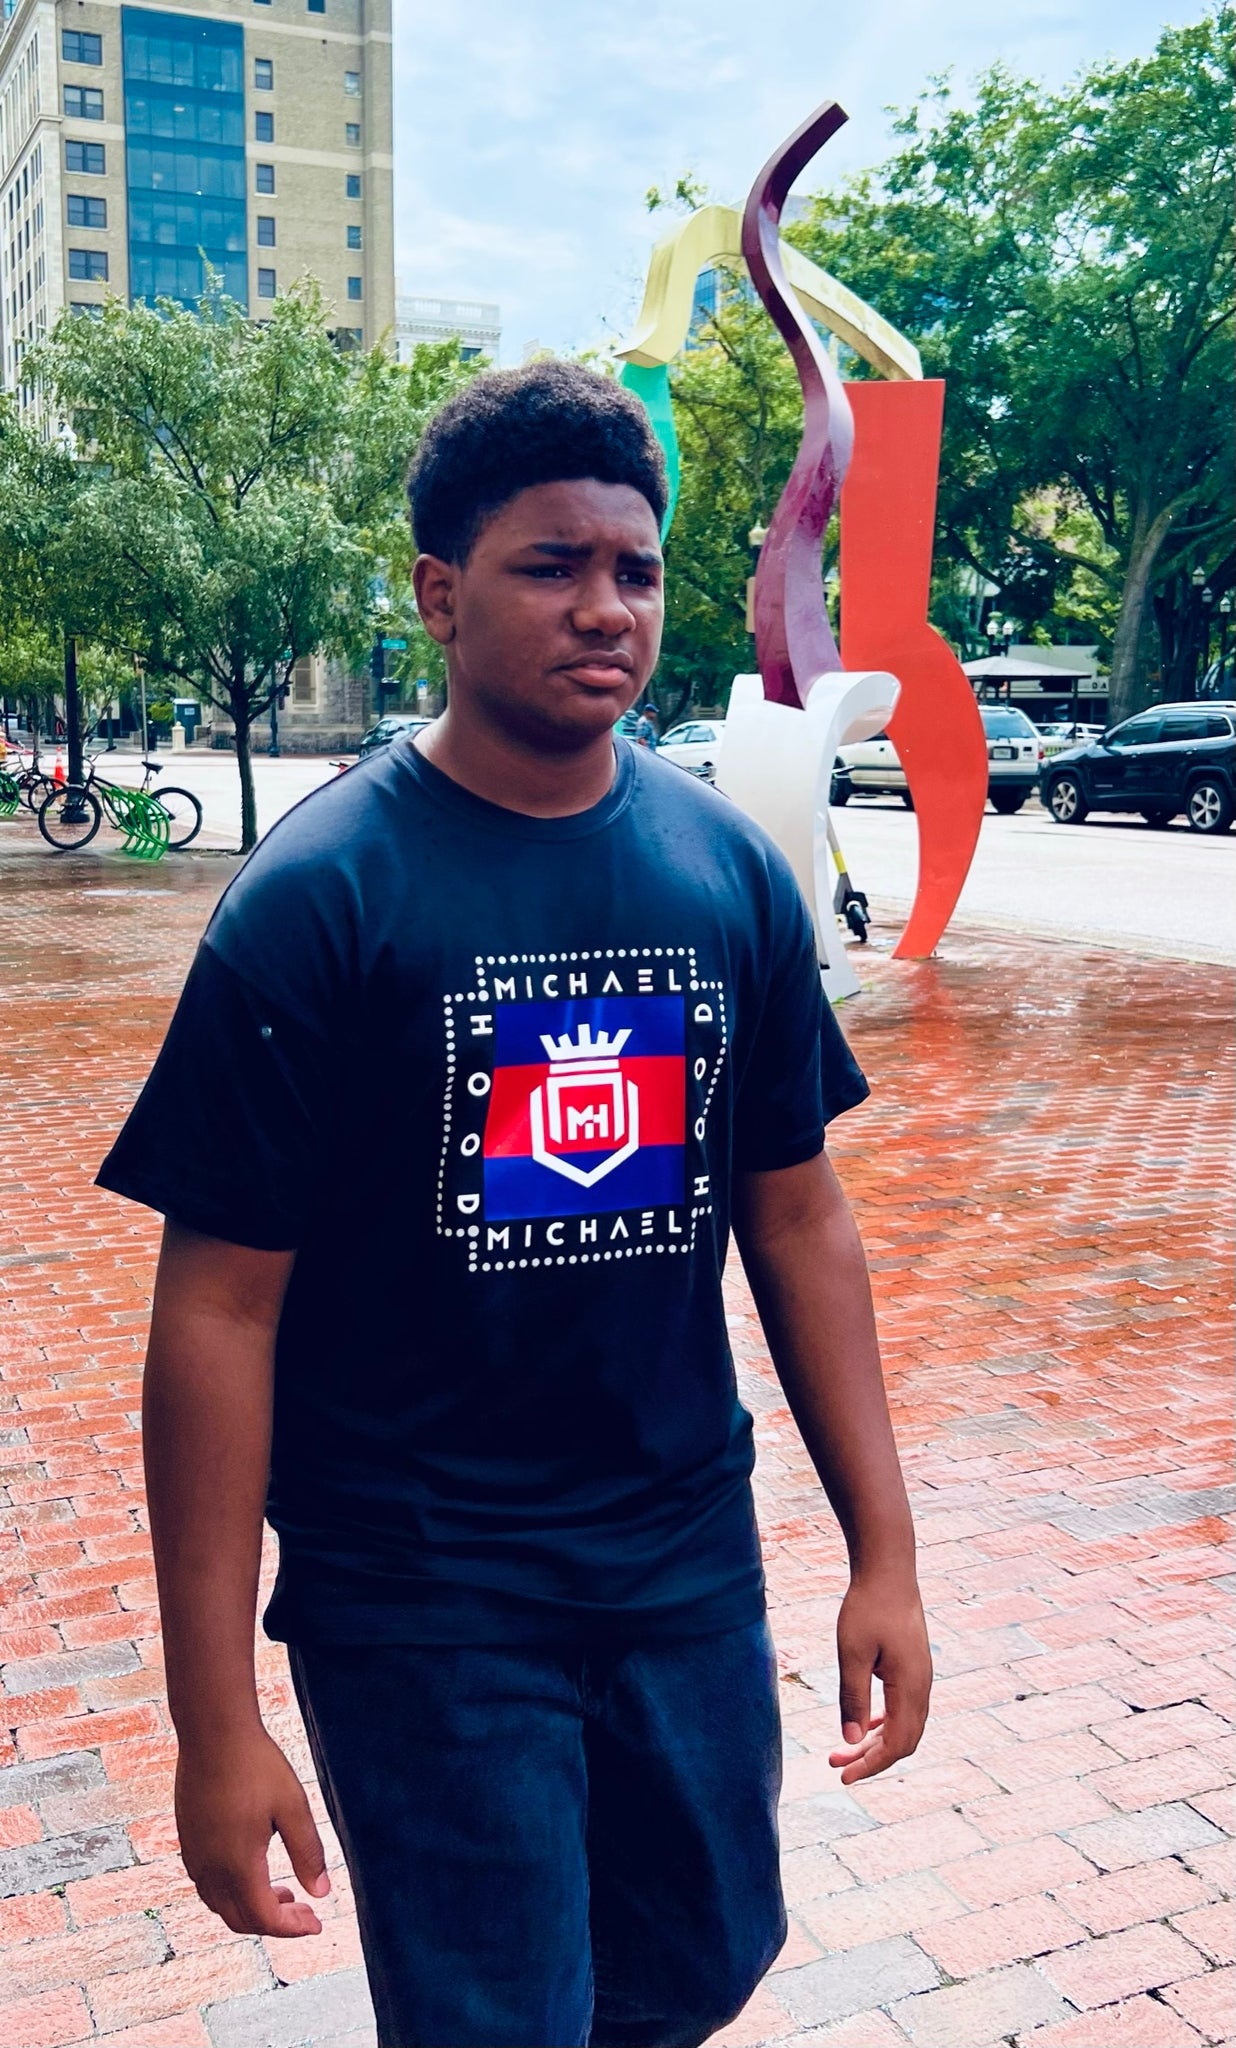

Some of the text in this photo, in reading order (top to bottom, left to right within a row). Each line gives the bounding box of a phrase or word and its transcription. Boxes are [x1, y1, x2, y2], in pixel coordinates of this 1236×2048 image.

[494, 968, 682, 1000] MICHAEL
[457, 1014, 493, 1215] HOOD
[694, 1003, 713, 1196] HOOD
[487, 1210, 682, 1251] MICHAEL
